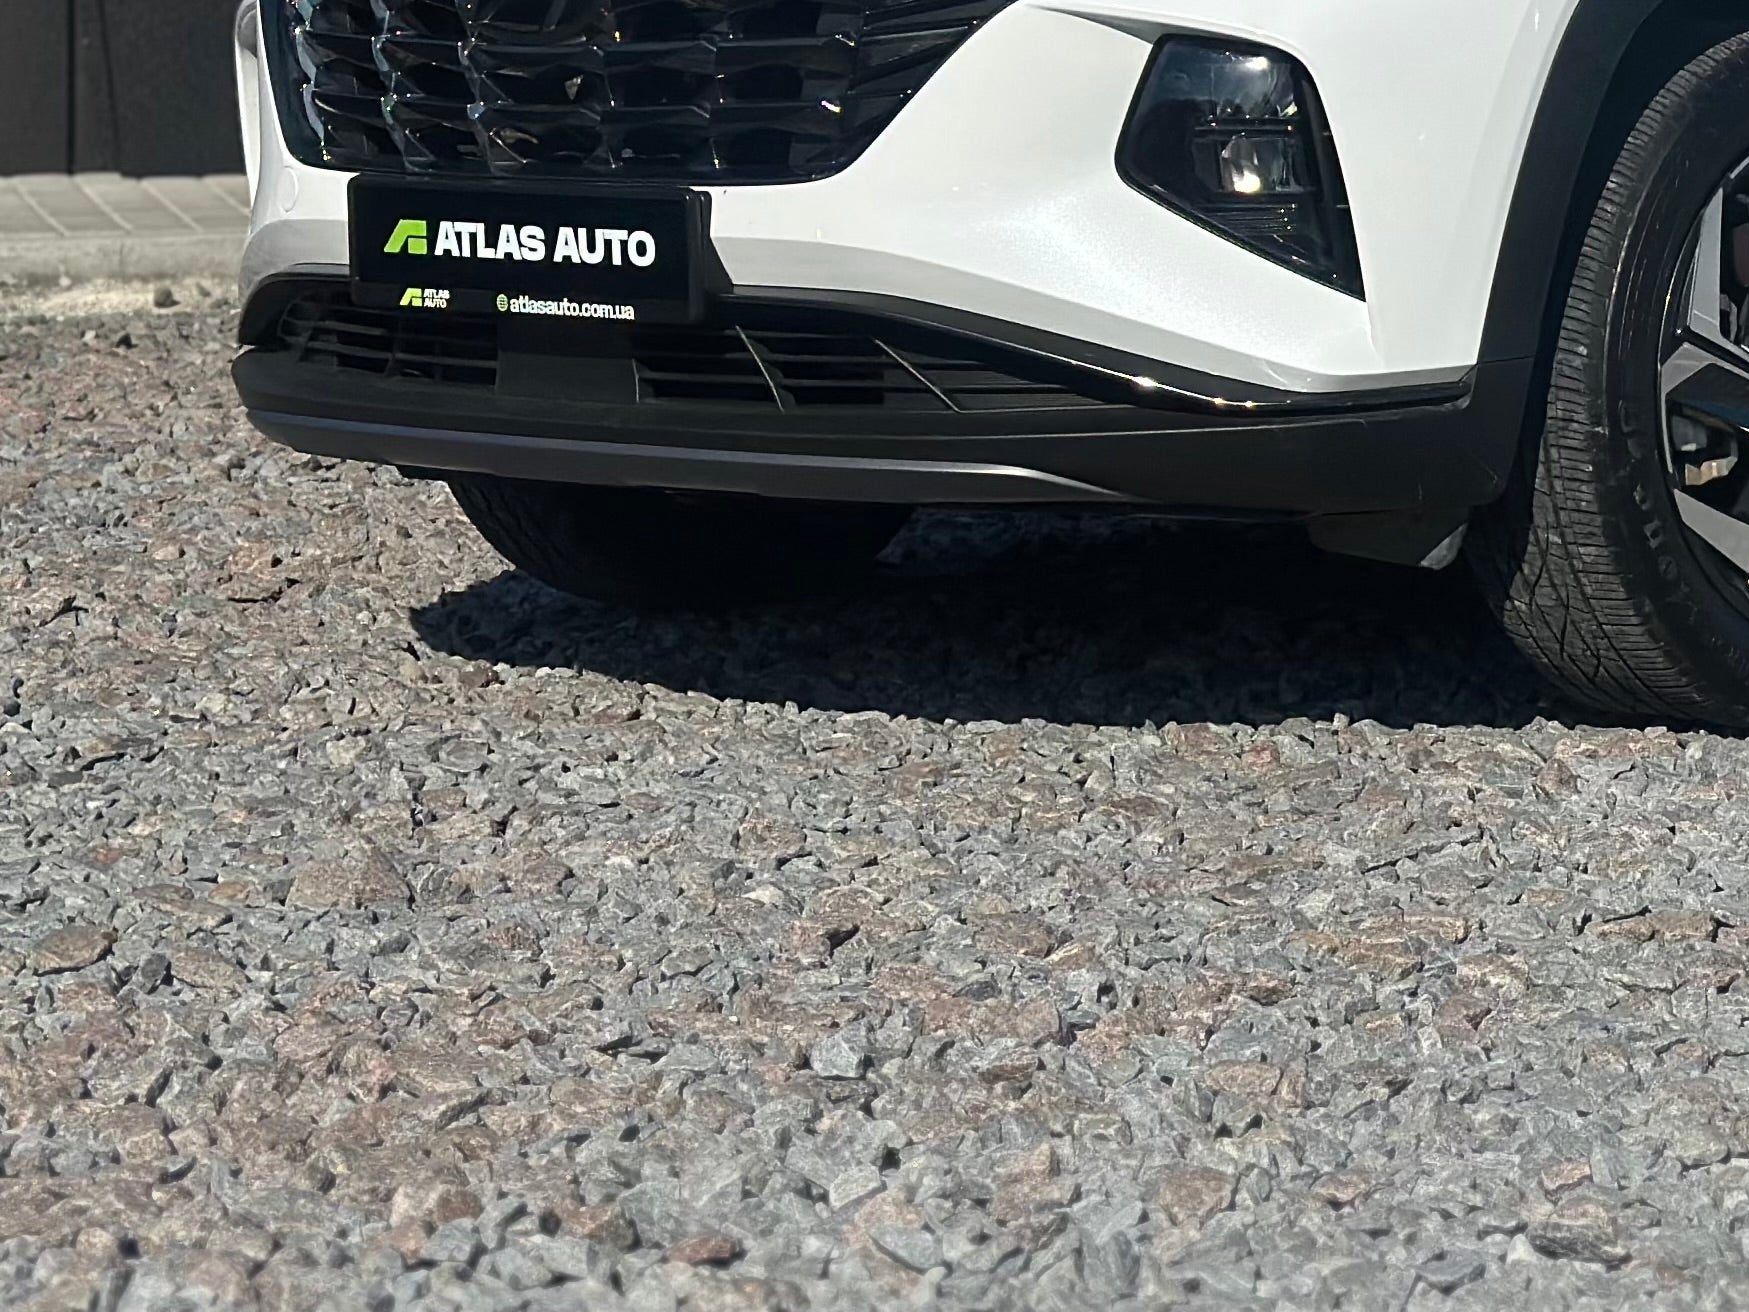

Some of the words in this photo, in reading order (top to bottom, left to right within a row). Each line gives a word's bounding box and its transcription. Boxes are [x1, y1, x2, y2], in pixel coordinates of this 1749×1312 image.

[434, 220, 546, 262] ATLAS
[553, 226, 656, 267] AUTO
[423, 288, 450, 300] ATLAS
[423, 298, 447, 309] AUTO
[510, 295, 636, 320] atlasauto.com.ua
